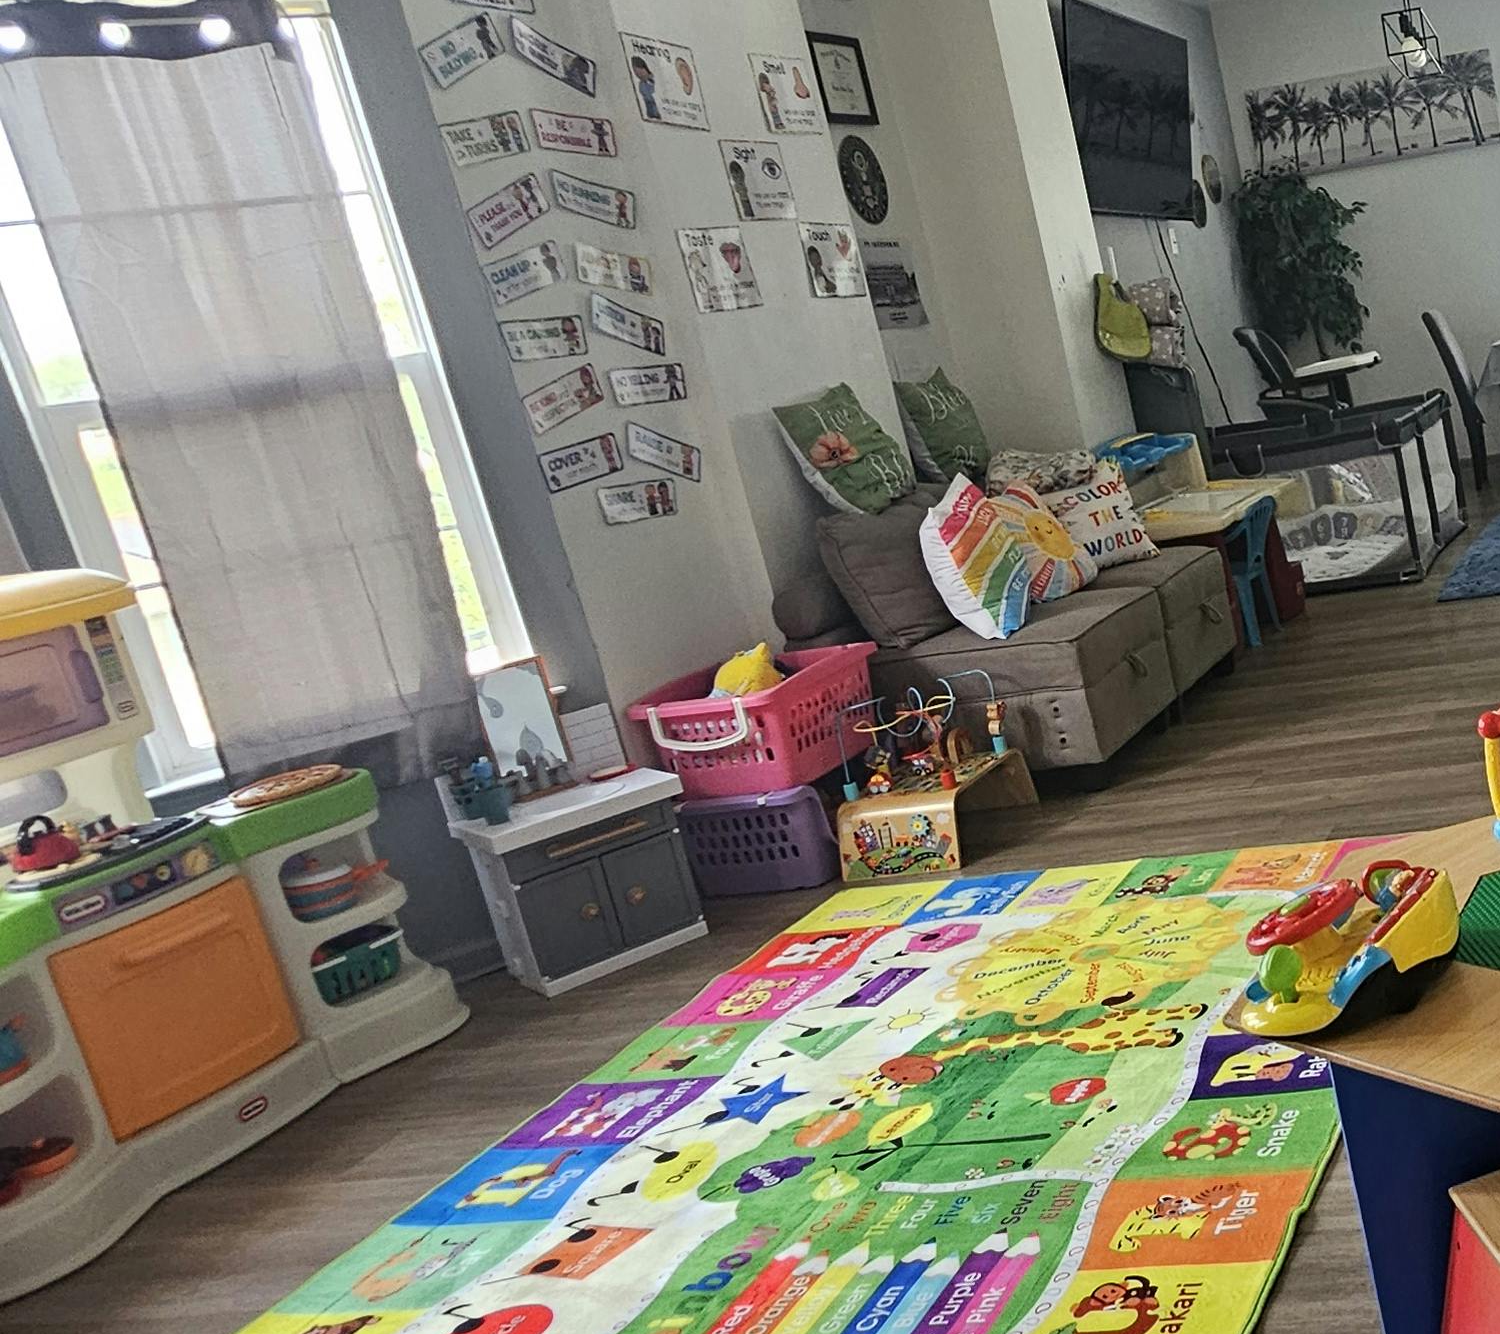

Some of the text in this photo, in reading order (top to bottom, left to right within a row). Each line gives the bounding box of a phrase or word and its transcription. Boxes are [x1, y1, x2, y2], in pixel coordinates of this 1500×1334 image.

[630, 38, 672, 63] Hearing
[761, 60, 787, 76] Smell
[446, 126, 475, 144] TAKE
[478, 200, 508, 226] PLEASE
[684, 232, 715, 248] Taste
[805, 227, 832, 243] Touch
[489, 266, 520, 285] CLEAN
[518, 259, 532, 274] UP
[546, 451, 584, 473] COVER
[1063, 481, 1122, 509] COLOR
[1088, 505, 1123, 528] THE
[1082, 528, 1144, 558] WORLD
[1141, 918, 1181, 935] May
[1143, 933, 1192, 947] June
[973, 955, 1066, 980] December
[1138, 949, 1177, 960] July
[772, 973, 826, 1012] Giraffe
[976, 963, 1067, 999] November
[1024, 966, 1075, 1006] October
[1080, 962, 1101, 1004] September
[703, 1038, 741, 1063] Fox
[615, 1077, 701, 1140] Elephant
[876, 1106, 922, 1141] Lemon
[1256, 1108, 1301, 1159] Snake
[527, 1167, 586, 1202] Dog
[665, 1157, 703, 1185] Oval
[862, 1194, 914, 1239] Three
[899, 1197, 940, 1231] Four
[934, 1194, 972, 1227] Five
[970, 1200, 1000, 1226] Six
[1000, 1178, 1049, 1228] Seven
[1038, 1180, 1081, 1225] Eight
[1213, 1188, 1261, 1236] Tiger
[442, 1247, 494, 1279] Cat
[560, 1227, 622, 1275] Square
[855, 1284, 907, 1334] Cyan
[895, 1289, 935, 1330] Blue
[928, 1270, 984, 1327] Purple
[964, 1284, 1008, 1325] Pink
